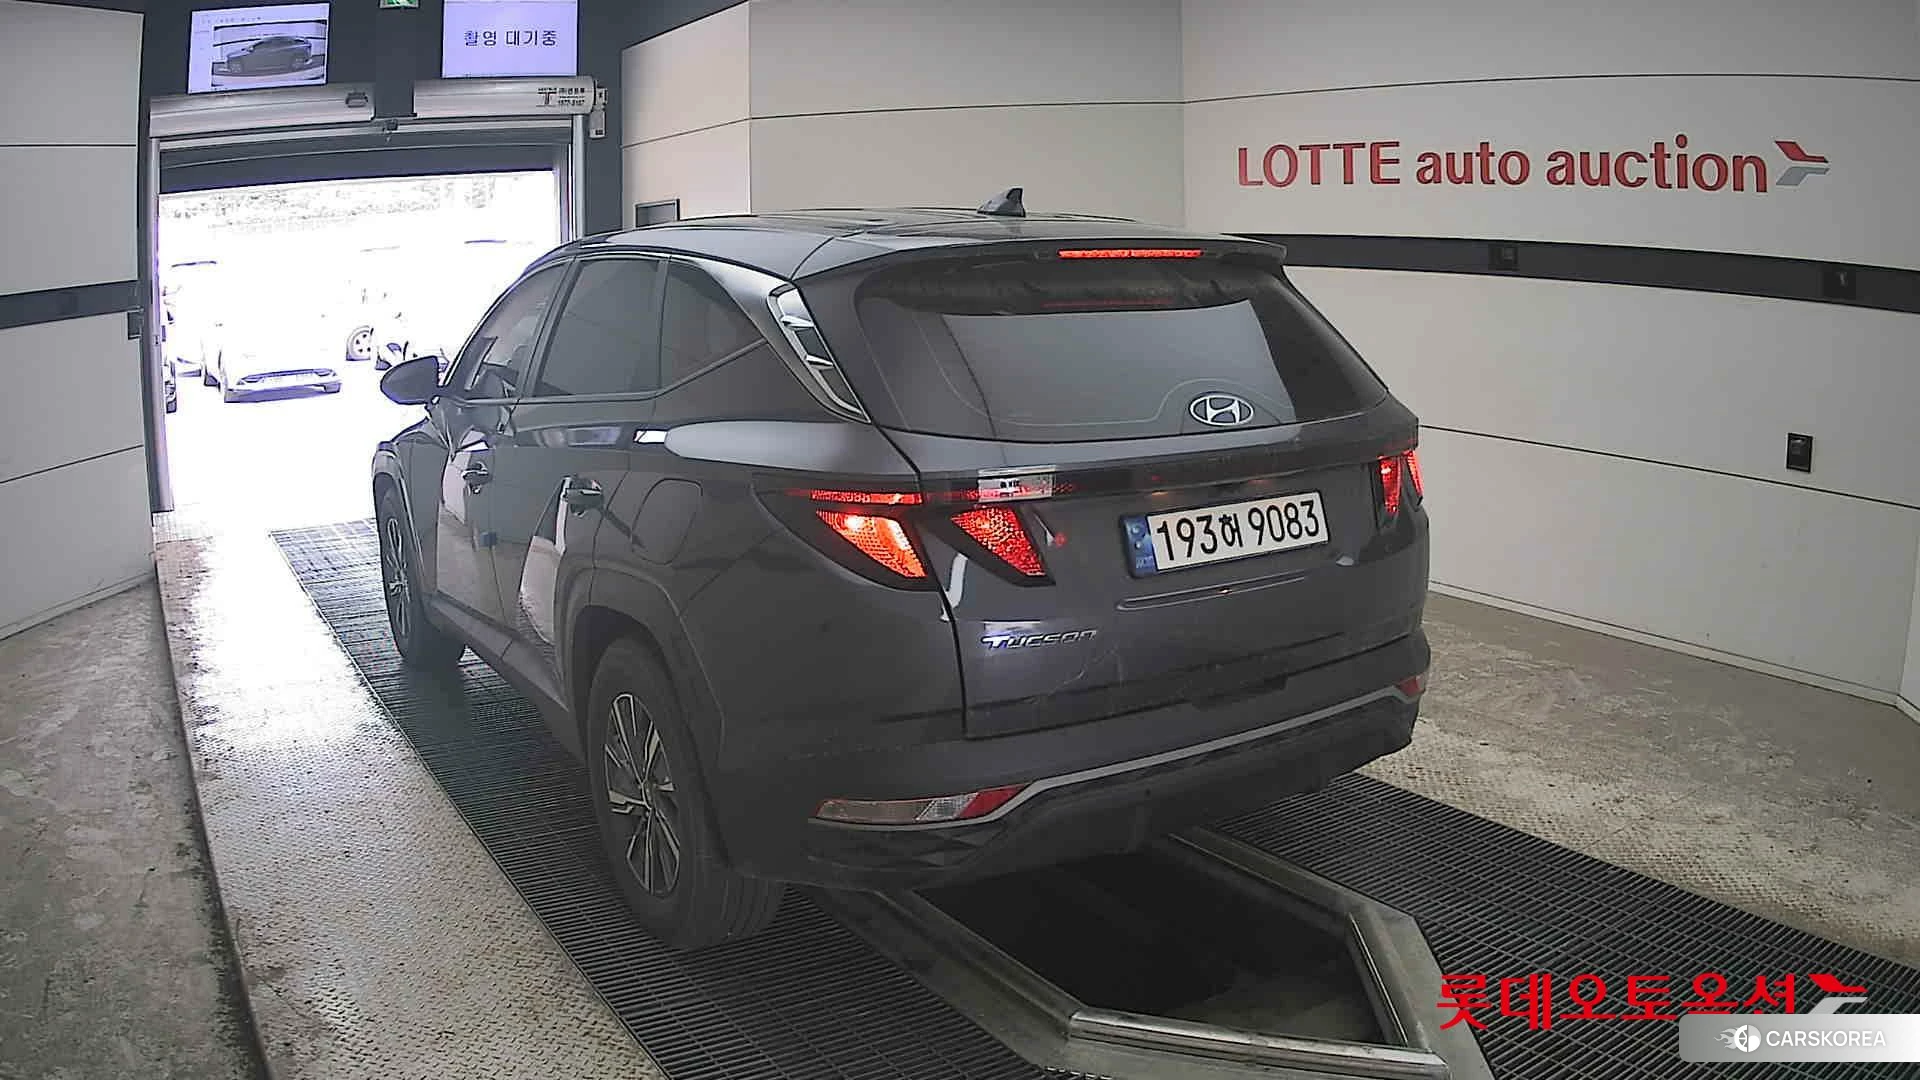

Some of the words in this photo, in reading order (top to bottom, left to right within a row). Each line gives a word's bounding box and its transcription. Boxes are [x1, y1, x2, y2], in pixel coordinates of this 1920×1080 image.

[463, 30, 497, 47] 촬영
[505, 29, 557, 47] 대기중
[1238, 141, 1400, 187] LOTTE
[1415, 141, 1530, 186] auto
[1546, 134, 1768, 193] auction
[1156, 512, 1243, 561] 193허
[1247, 499, 1320, 546] 9083
[980, 629, 1097, 648] TUCSON
